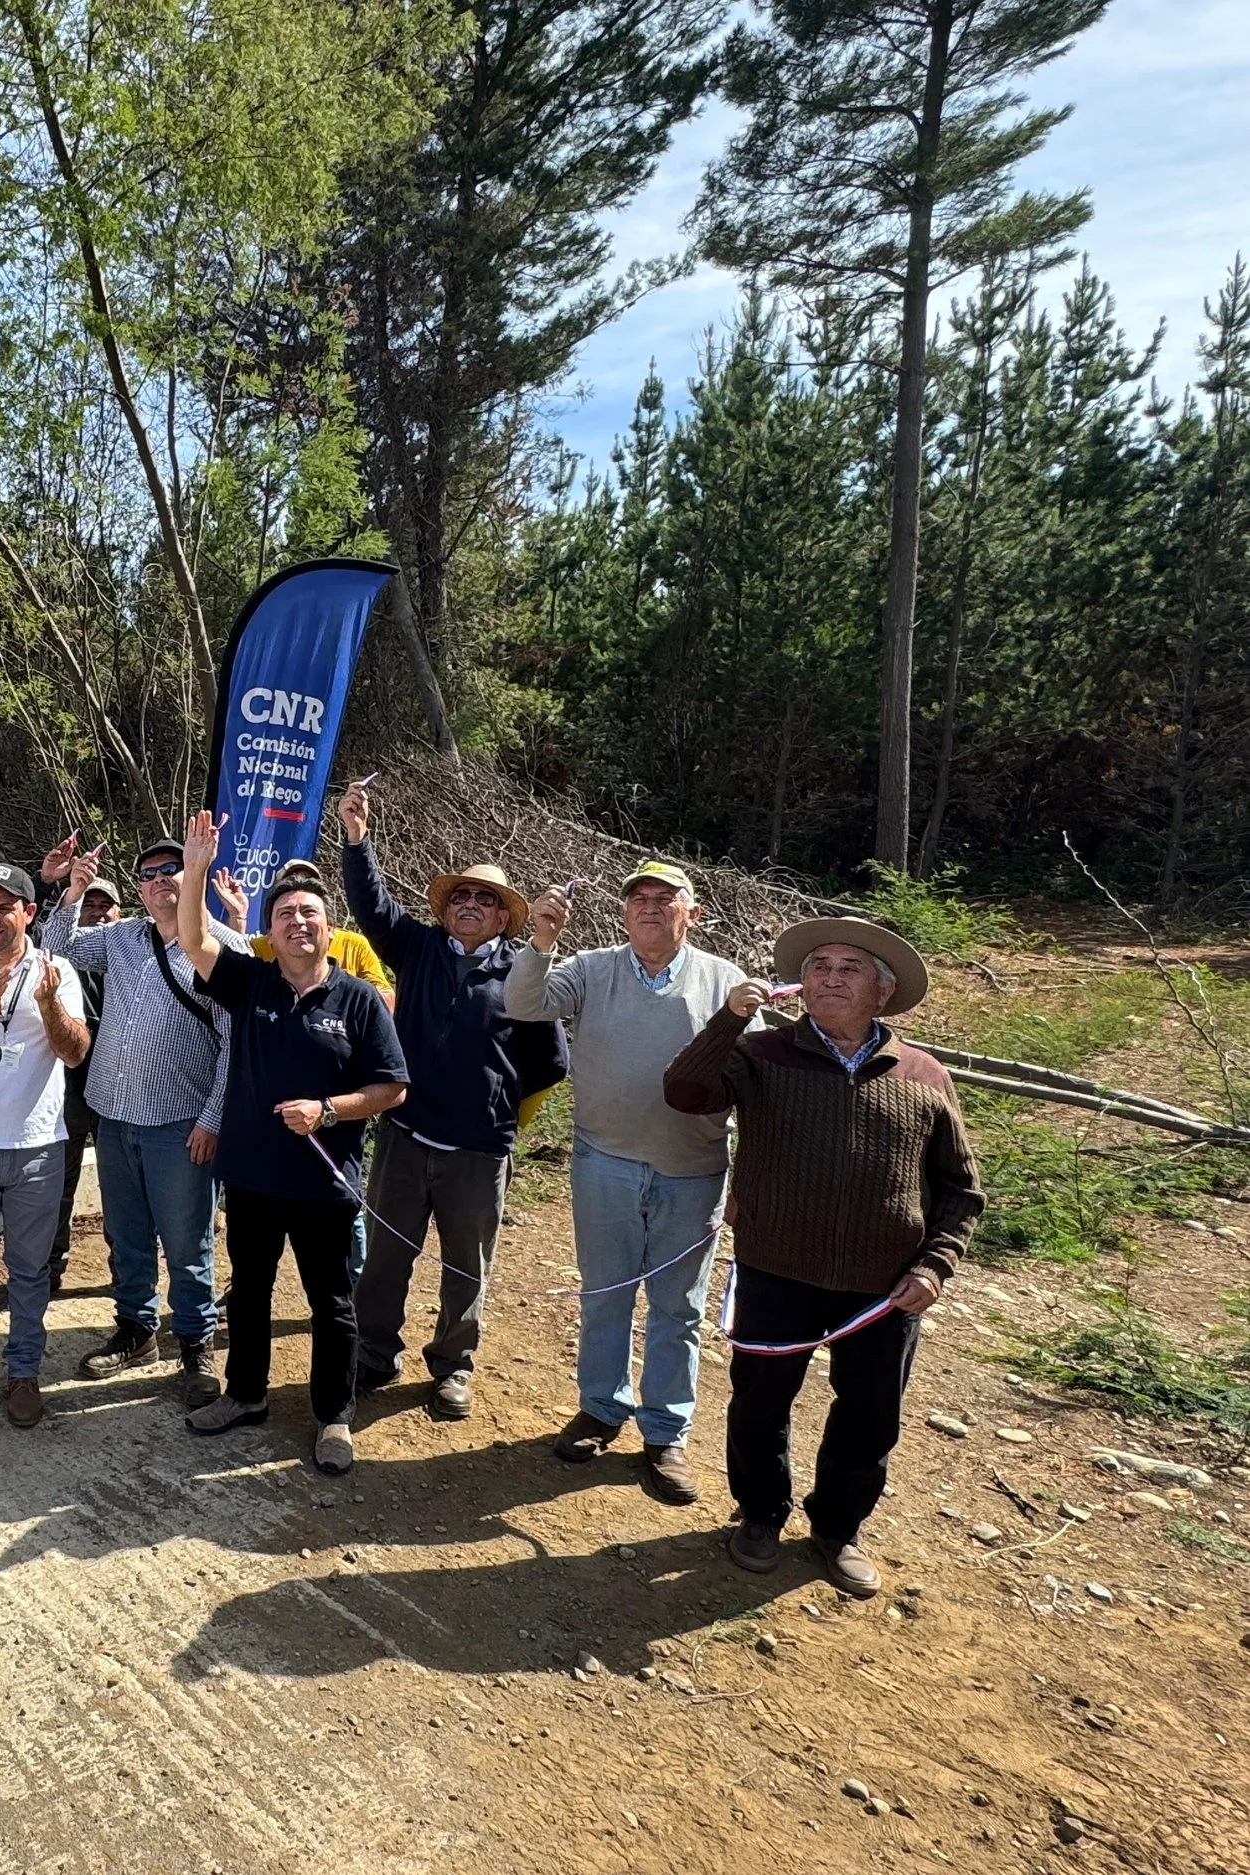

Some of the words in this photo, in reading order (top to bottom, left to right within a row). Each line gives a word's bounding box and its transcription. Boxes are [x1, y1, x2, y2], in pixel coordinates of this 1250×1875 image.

[240, 687, 325, 735] CNR
[236, 733, 316, 761] Comisión
[235, 843, 280, 867] cuido
[233, 867, 276, 897] agu
[322, 1018, 344, 1028] CNR
